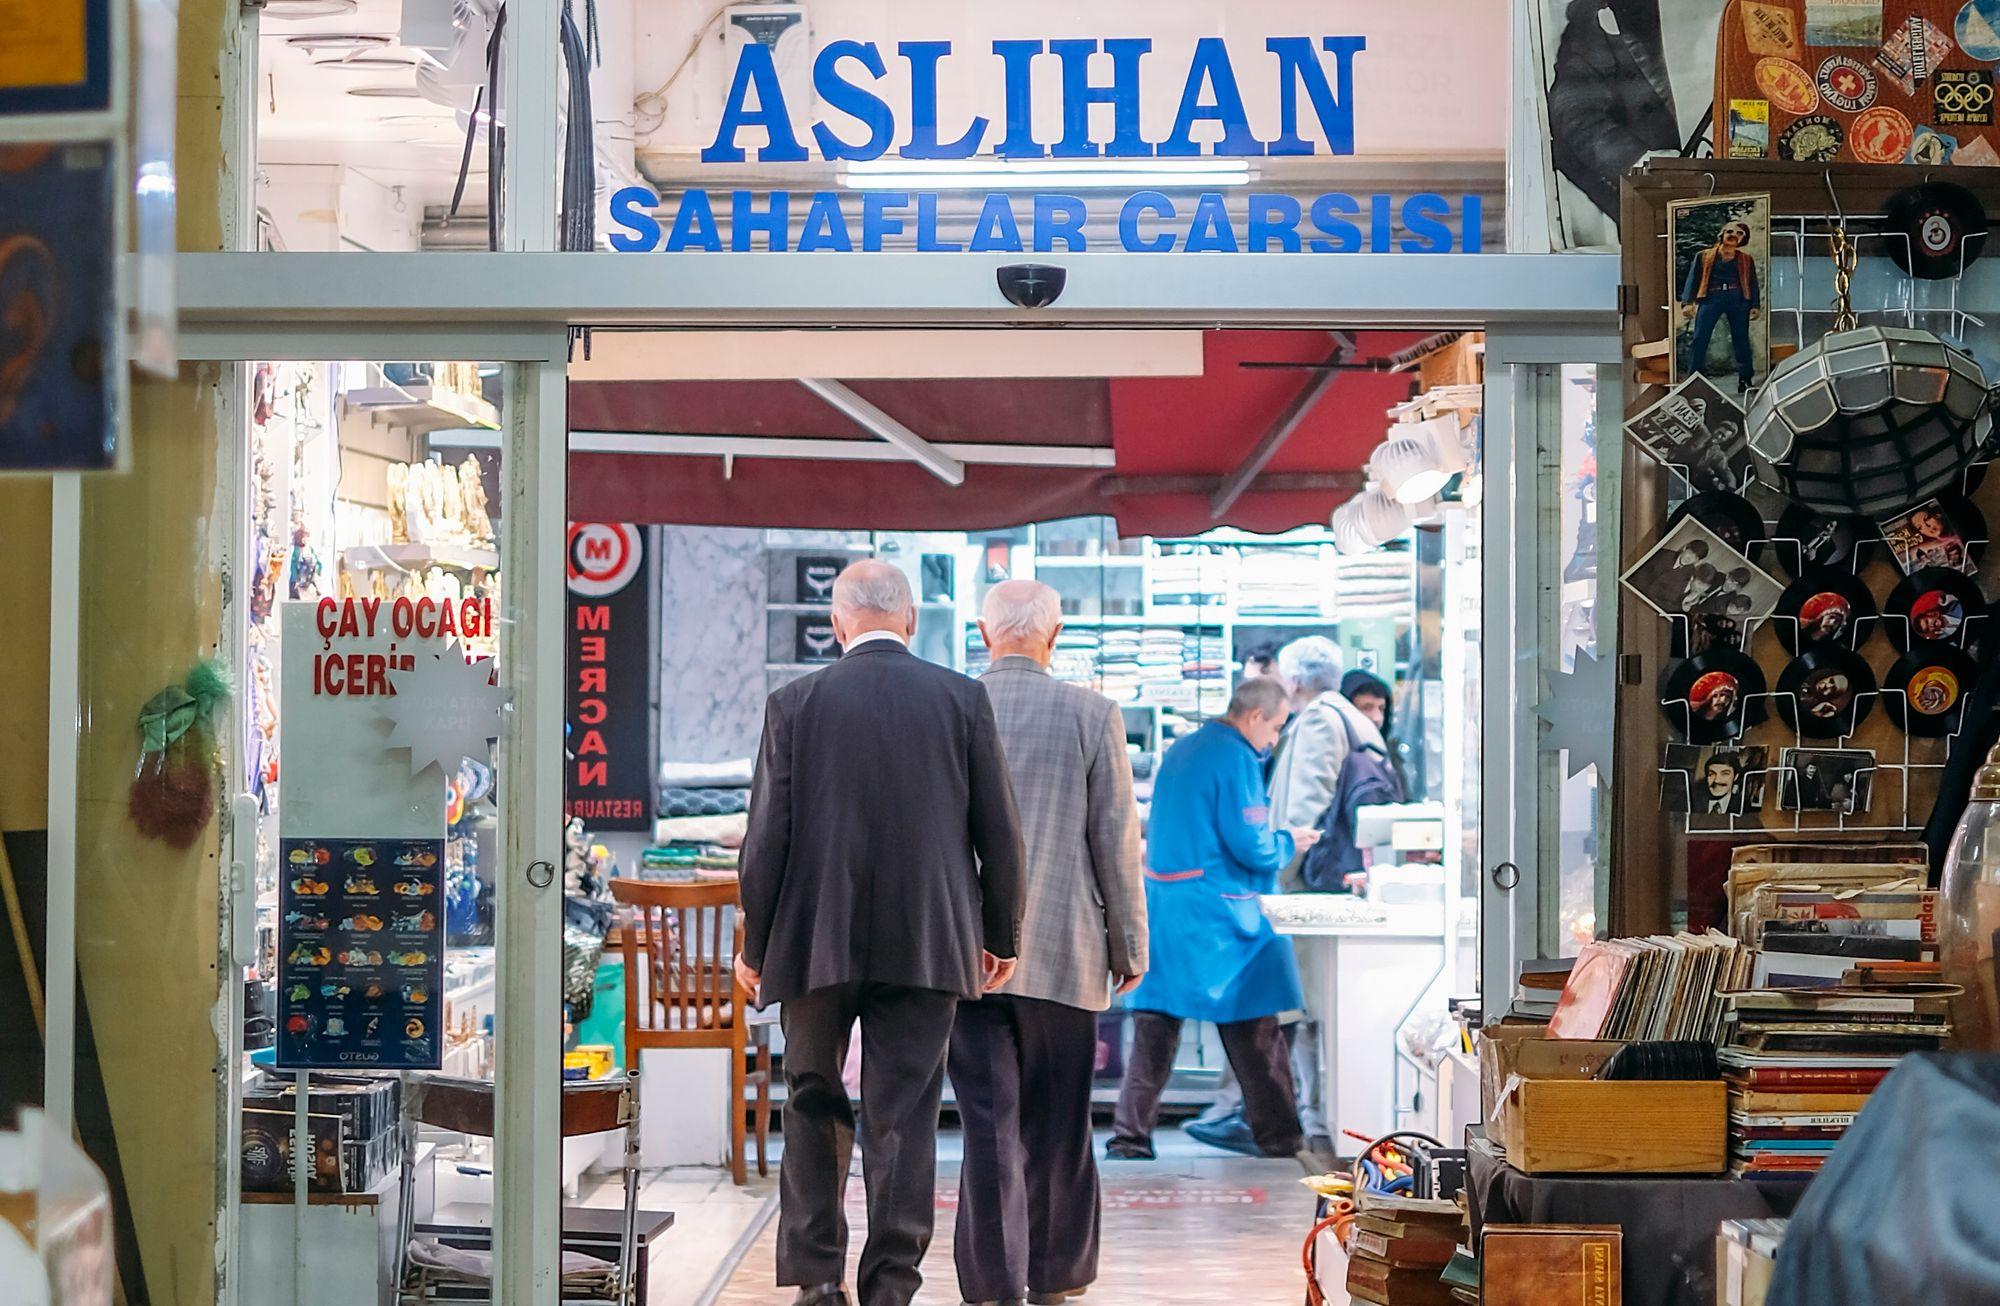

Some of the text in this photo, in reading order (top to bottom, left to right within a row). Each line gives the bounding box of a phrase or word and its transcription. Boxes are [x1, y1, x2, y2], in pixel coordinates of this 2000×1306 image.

[701, 36, 1366, 162] ASLIHAN
[609, 186, 1482, 253] SAHAFLAR CARSISI
[316, 597, 381, 650] ÇAY
